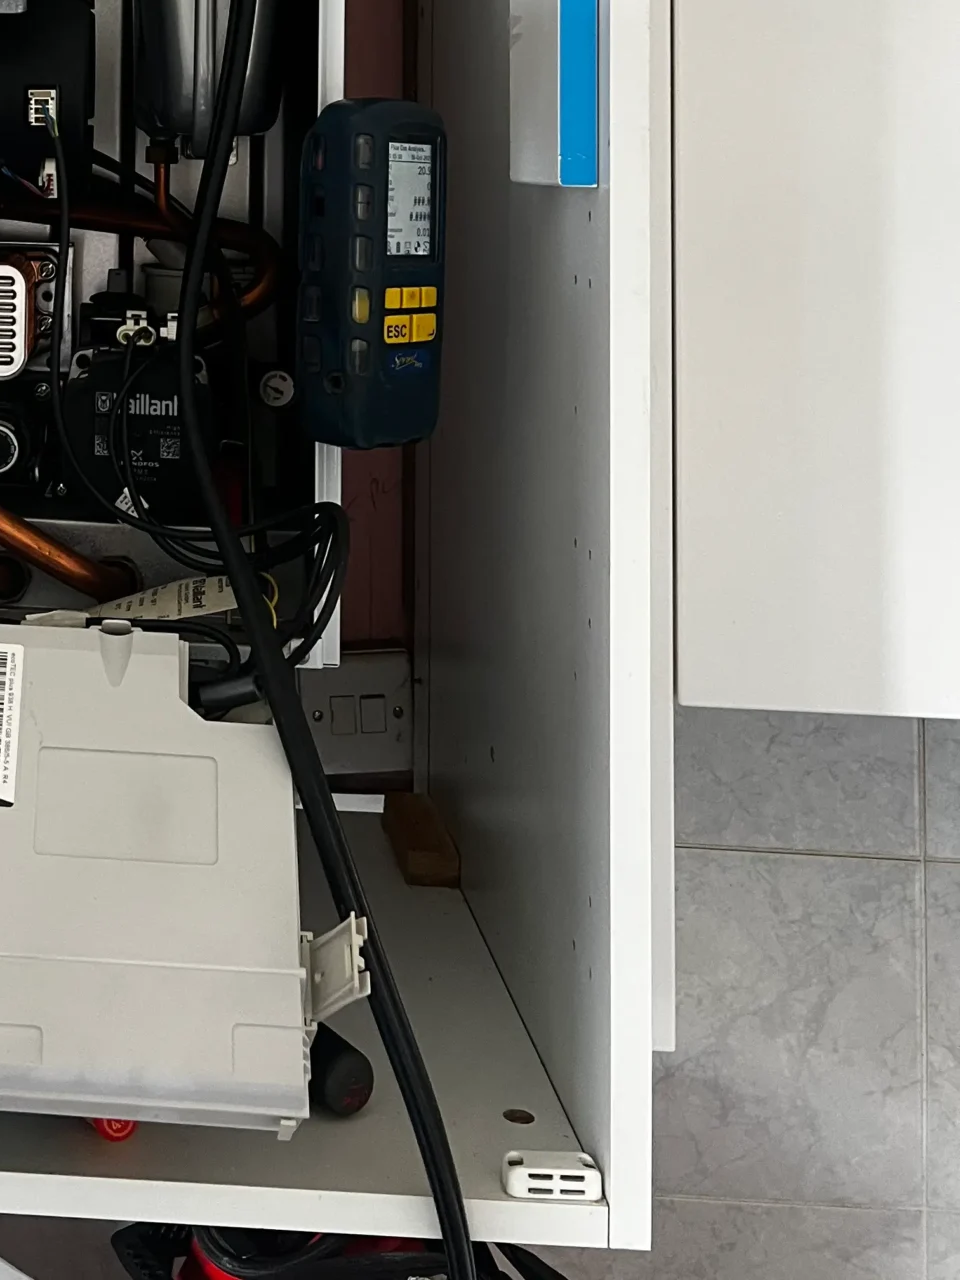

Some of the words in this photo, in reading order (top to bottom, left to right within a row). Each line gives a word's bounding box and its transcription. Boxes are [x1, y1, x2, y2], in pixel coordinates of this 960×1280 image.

[387, 324, 407, 339] ESC
[113, 392, 179, 417] aillant
[9, 652, 17, 676] ecoTEC
[7, 677, 15, 691] plus
[5, 727, 11, 738] GB
[1, 773, 8, 784] R4
